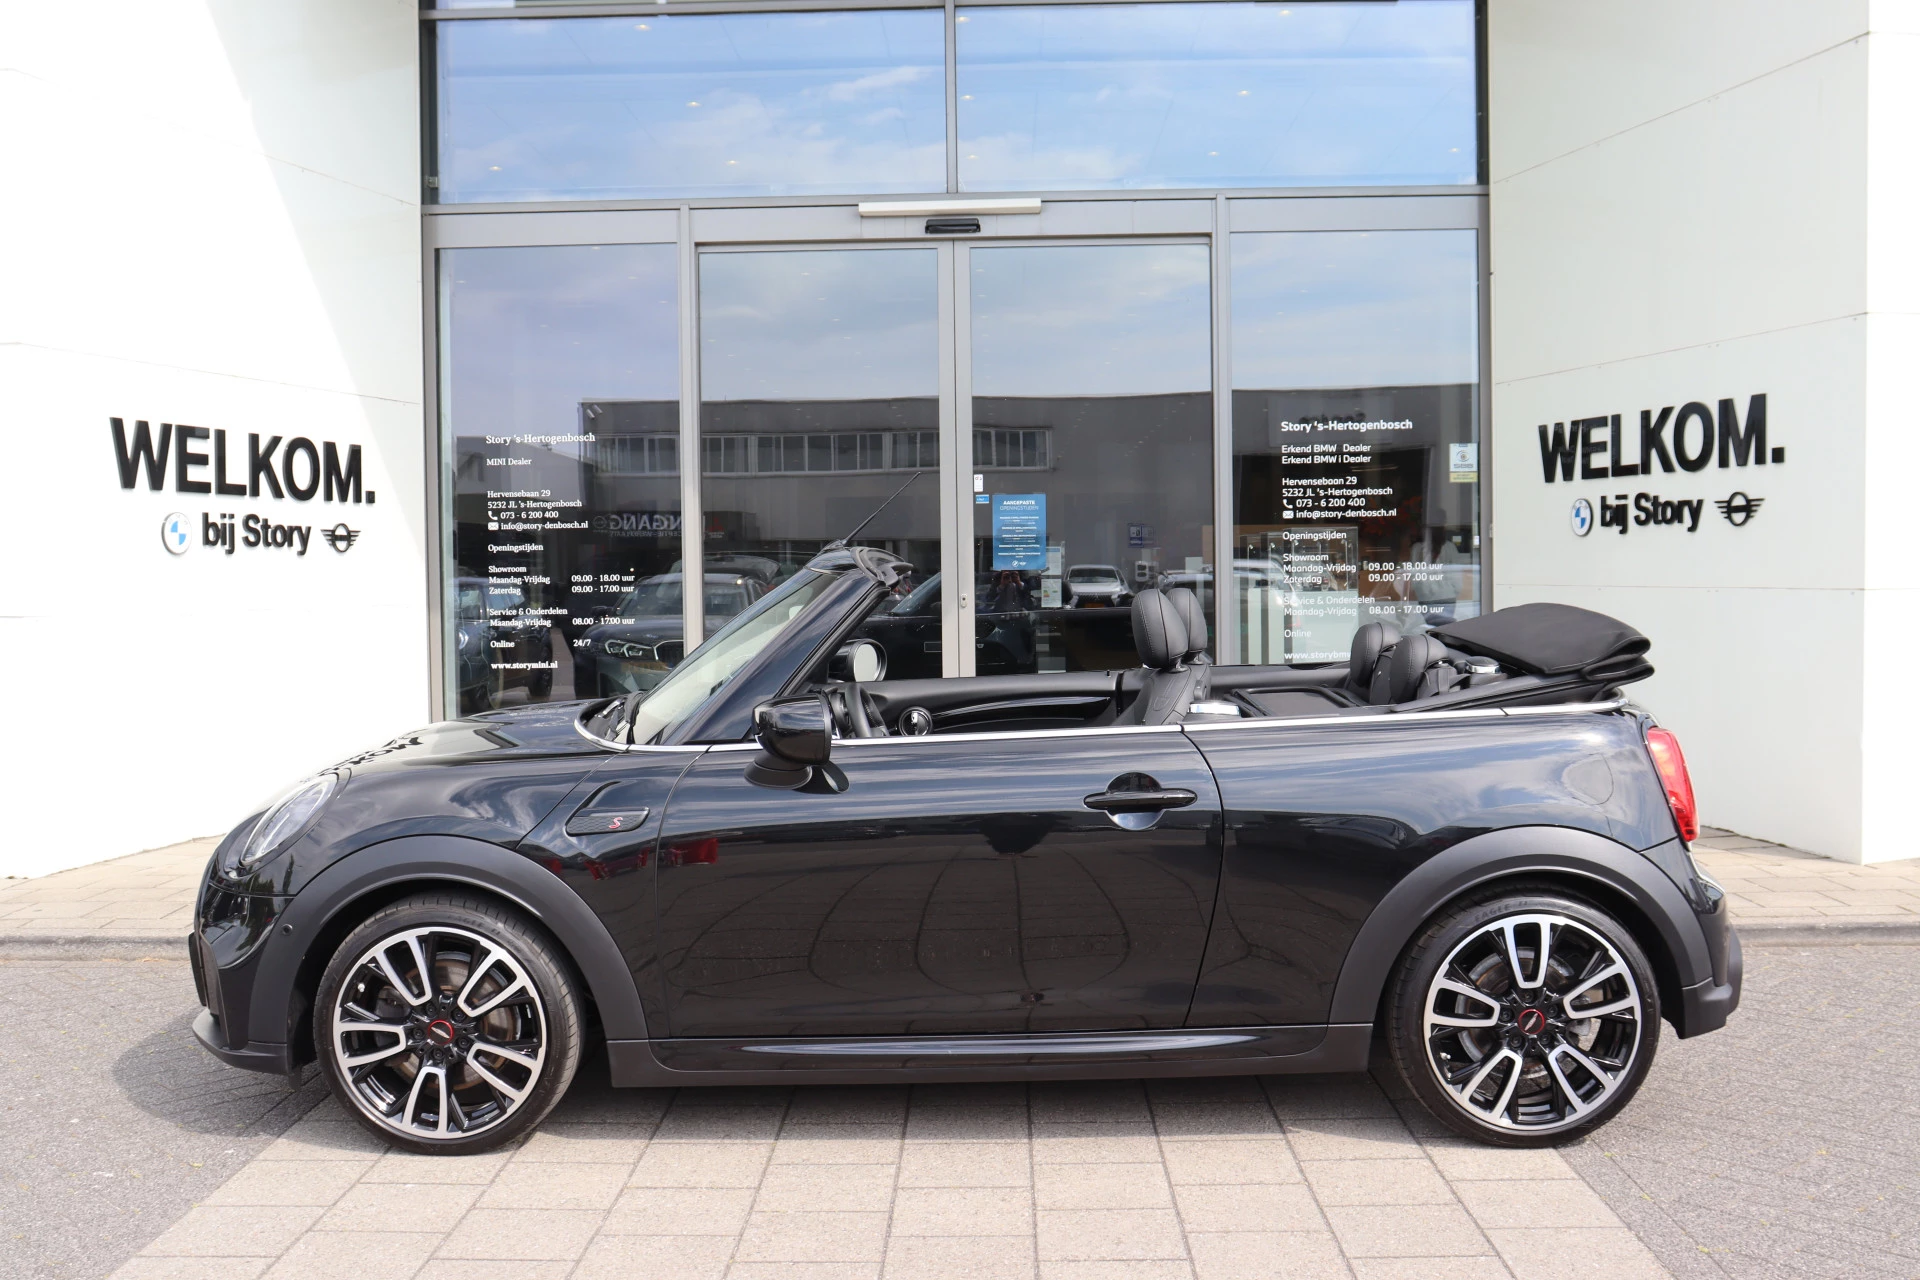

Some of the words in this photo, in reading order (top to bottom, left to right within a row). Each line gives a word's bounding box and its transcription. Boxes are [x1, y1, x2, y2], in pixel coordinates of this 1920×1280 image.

[1281, 421, 1312, 434] Story
[486, 435, 511, 446] Story
[1538, 393, 1786, 483] WELKOM.
[1281, 445, 1312, 454] Erkend
[1313, 444, 1337, 453] BMW
[1343, 443, 1371, 452] Dealer
[109, 417, 376, 504] WELKOM.
[486, 458, 506, 466] MINI
[508, 458, 532, 466] Dealer
[1281, 455, 1312, 464] Erkend
[1313, 455, 1337, 464] BMW
[1343, 454, 1372, 463] Dealer
[1282, 477, 1344, 486] Hervensebaan
[1346, 476, 1358, 484] 29
[487, 490, 540, 498] Hervensebaan
[541, 489, 551, 497] 29
[1282, 488, 1304, 497] 5232
[1305, 489, 1315, 497] JL
[487, 501, 506, 509] 5232
[1296, 499, 1312, 508] 073
[1320, 499, 1326, 507] 6
[1328, 498, 1346, 507] 200
[1347, 498, 1366, 506] 400
[528, 511, 543, 519] 200
[1296, 508, 1397, 519] info@story-denbosch.nl
[1600, 494, 1628, 534] bij
[1634, 492, 1704, 532] Story
[501, 521, 589, 532] info@story-denbosch.nl
[202, 512, 235, 554] bij
[242, 513, 312, 556] Story
[1283, 531, 1347, 541] Openingstijden
[488, 543, 544, 553] Openingstijden
[1283, 553, 1328, 562] Showroom
[488, 565, 527, 573] Showroom
[1283, 564, 1356, 574] Maandag-Vrijdag
[1368, 562, 1394, 571] 09.00
[1403, 562, 1427, 570] 18.00
[489, 575, 550, 584] Maandag-Vrijdag
[600, 574, 620, 582] 18.00
[1283, 575, 1322, 584] Zaterdag
[1369, 573, 1394, 582] 09.00
[489, 586, 521, 596] Zaterdag
[572, 585, 593, 593] 09.00
[600, 585, 620, 593] 17.00
[1326, 596, 1376, 604] Onderdelen
[489, 608, 517, 616] Service
[525, 607, 568, 615] Onderdelen
[1284, 607, 1357, 617] Maandag-Vrijdag
[1369, 606, 1395, 615] 08.00
[490, 618, 552, 628] Maandag-Vrijdag
[572, 618, 594, 626] 08.00
[1284, 630, 1312, 638] Online
[490, 640, 515, 648] Online
[573, 639, 591, 647] 24/7
[491, 661, 558, 670] www.storymini.nl
[608, 817, 624, 829] S
